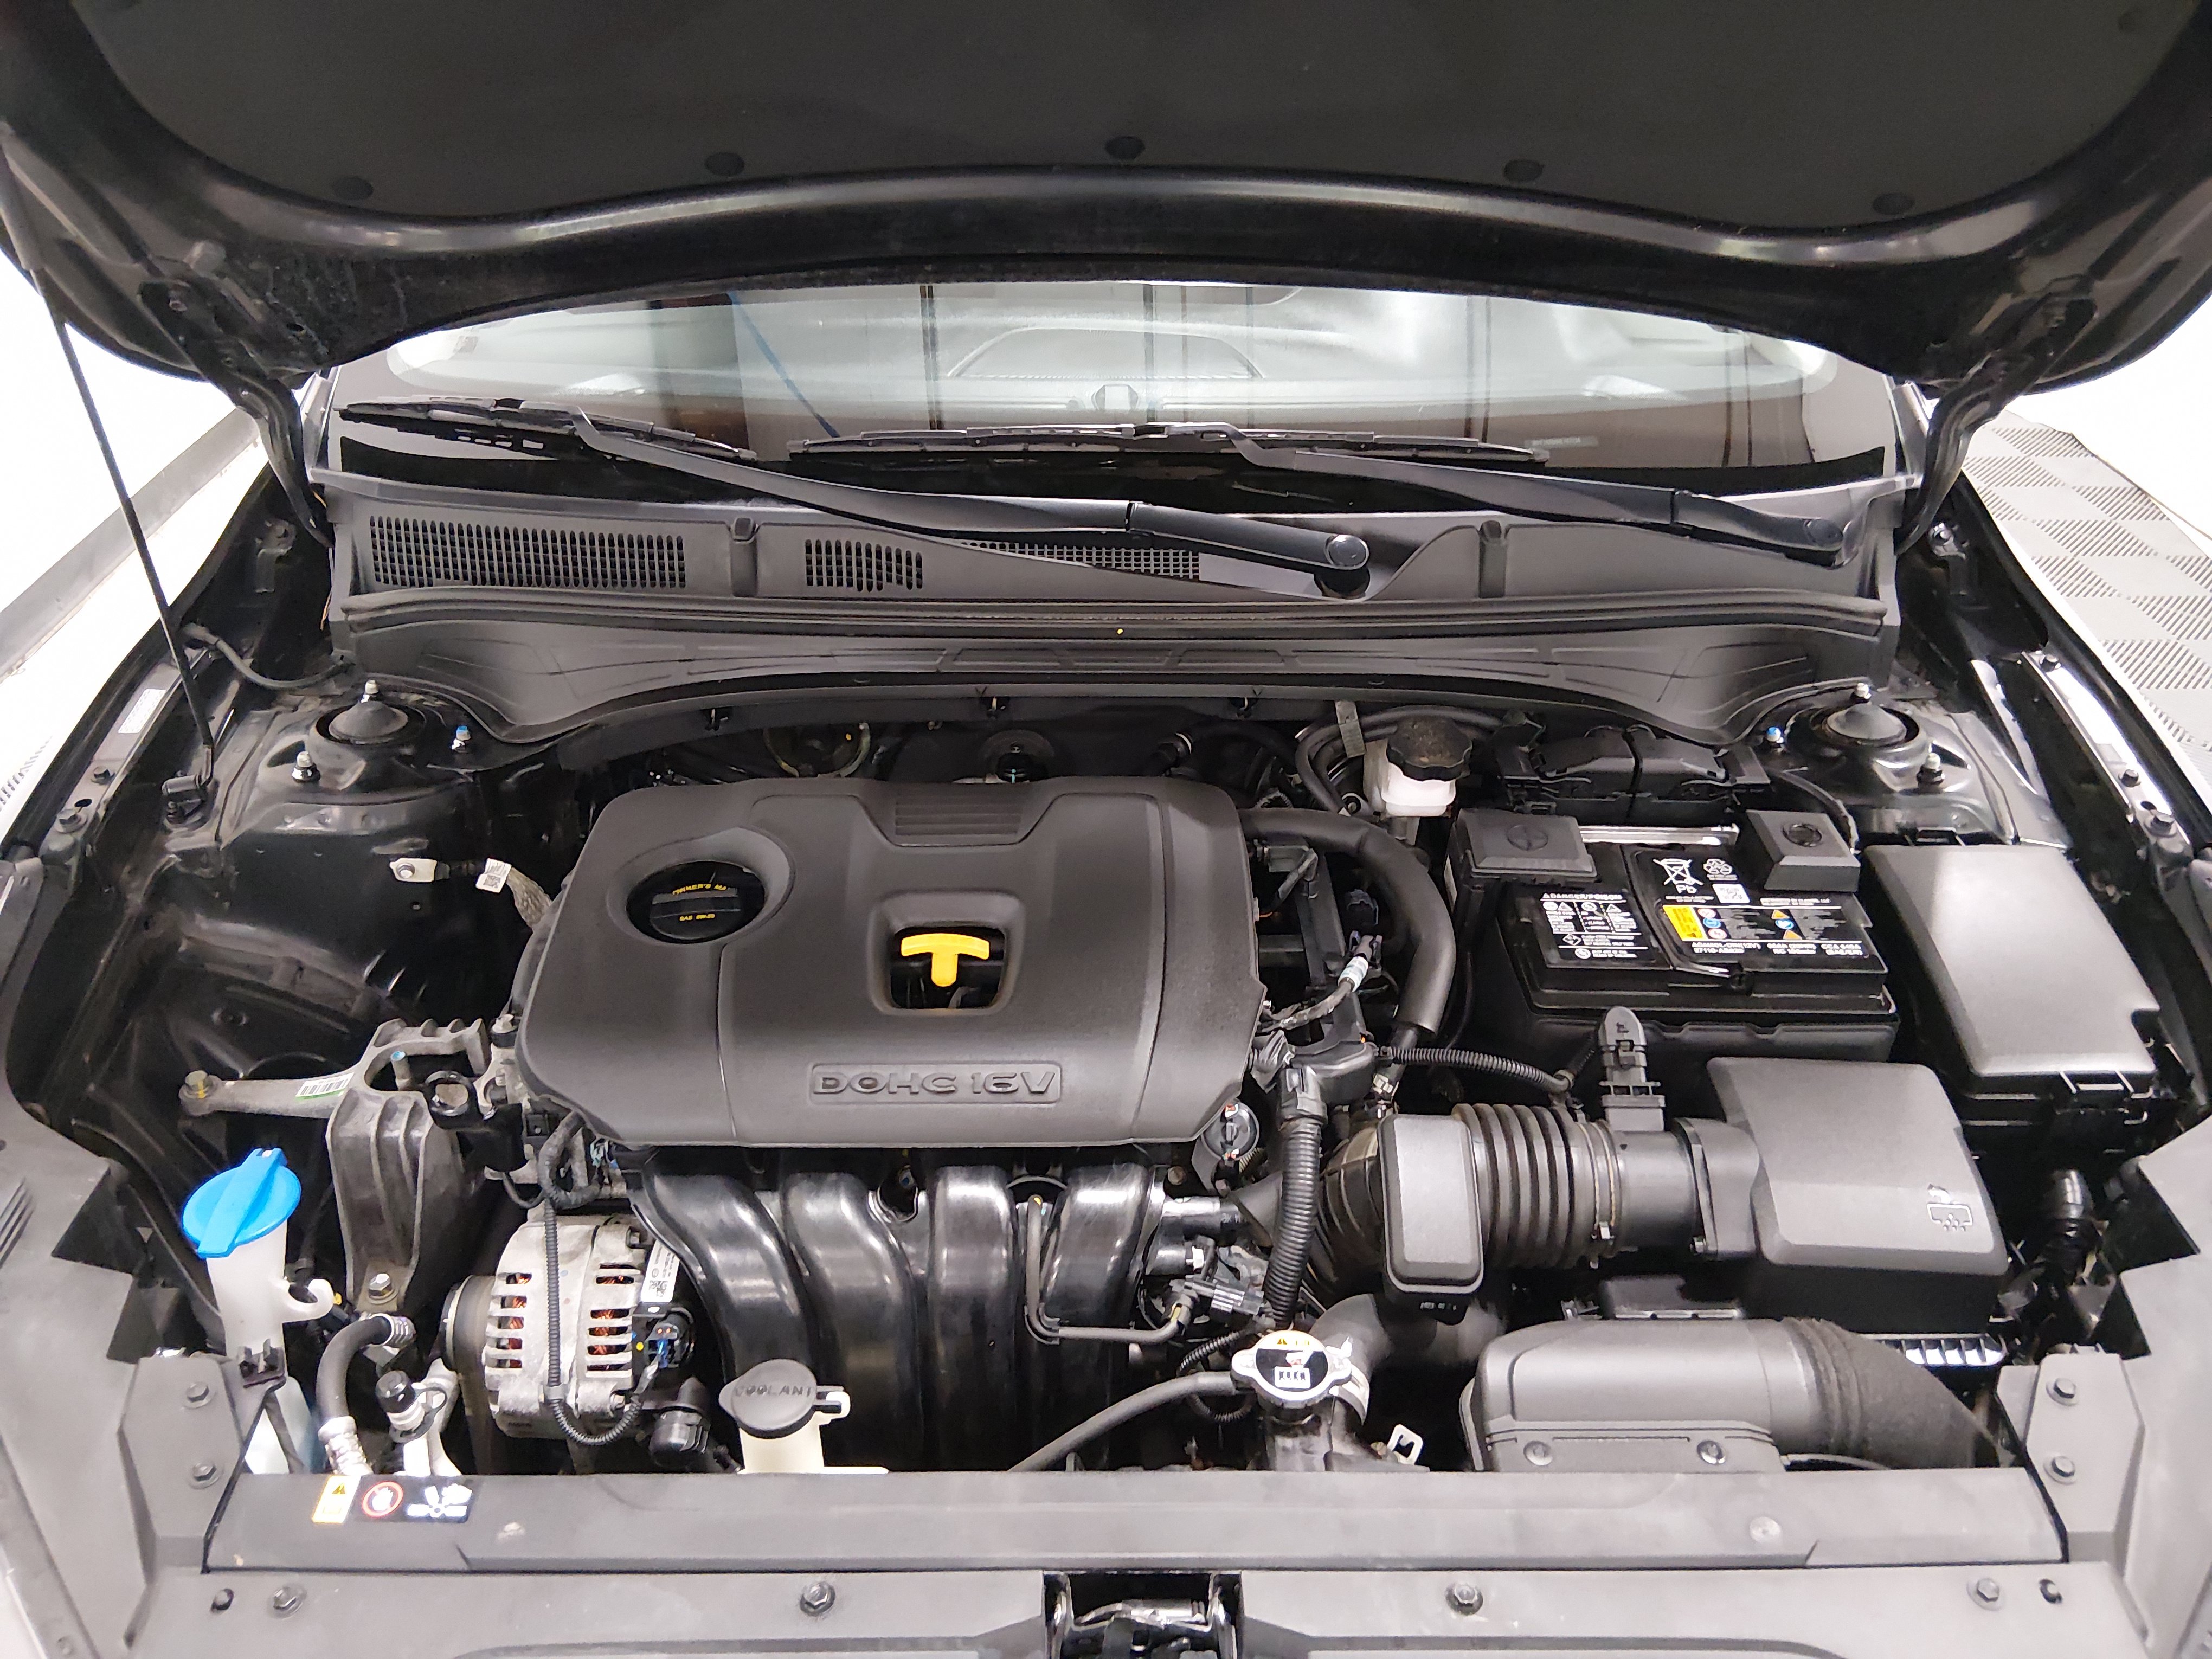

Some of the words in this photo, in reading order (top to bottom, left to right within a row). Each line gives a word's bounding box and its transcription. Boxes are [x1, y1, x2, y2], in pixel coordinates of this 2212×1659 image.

[1675, 884, 1697, 893] Pb
[813, 1072, 957, 1094] DOHC
[970, 1071, 1056, 1094] 16V
[734, 1384, 813, 1398] COOLANT
